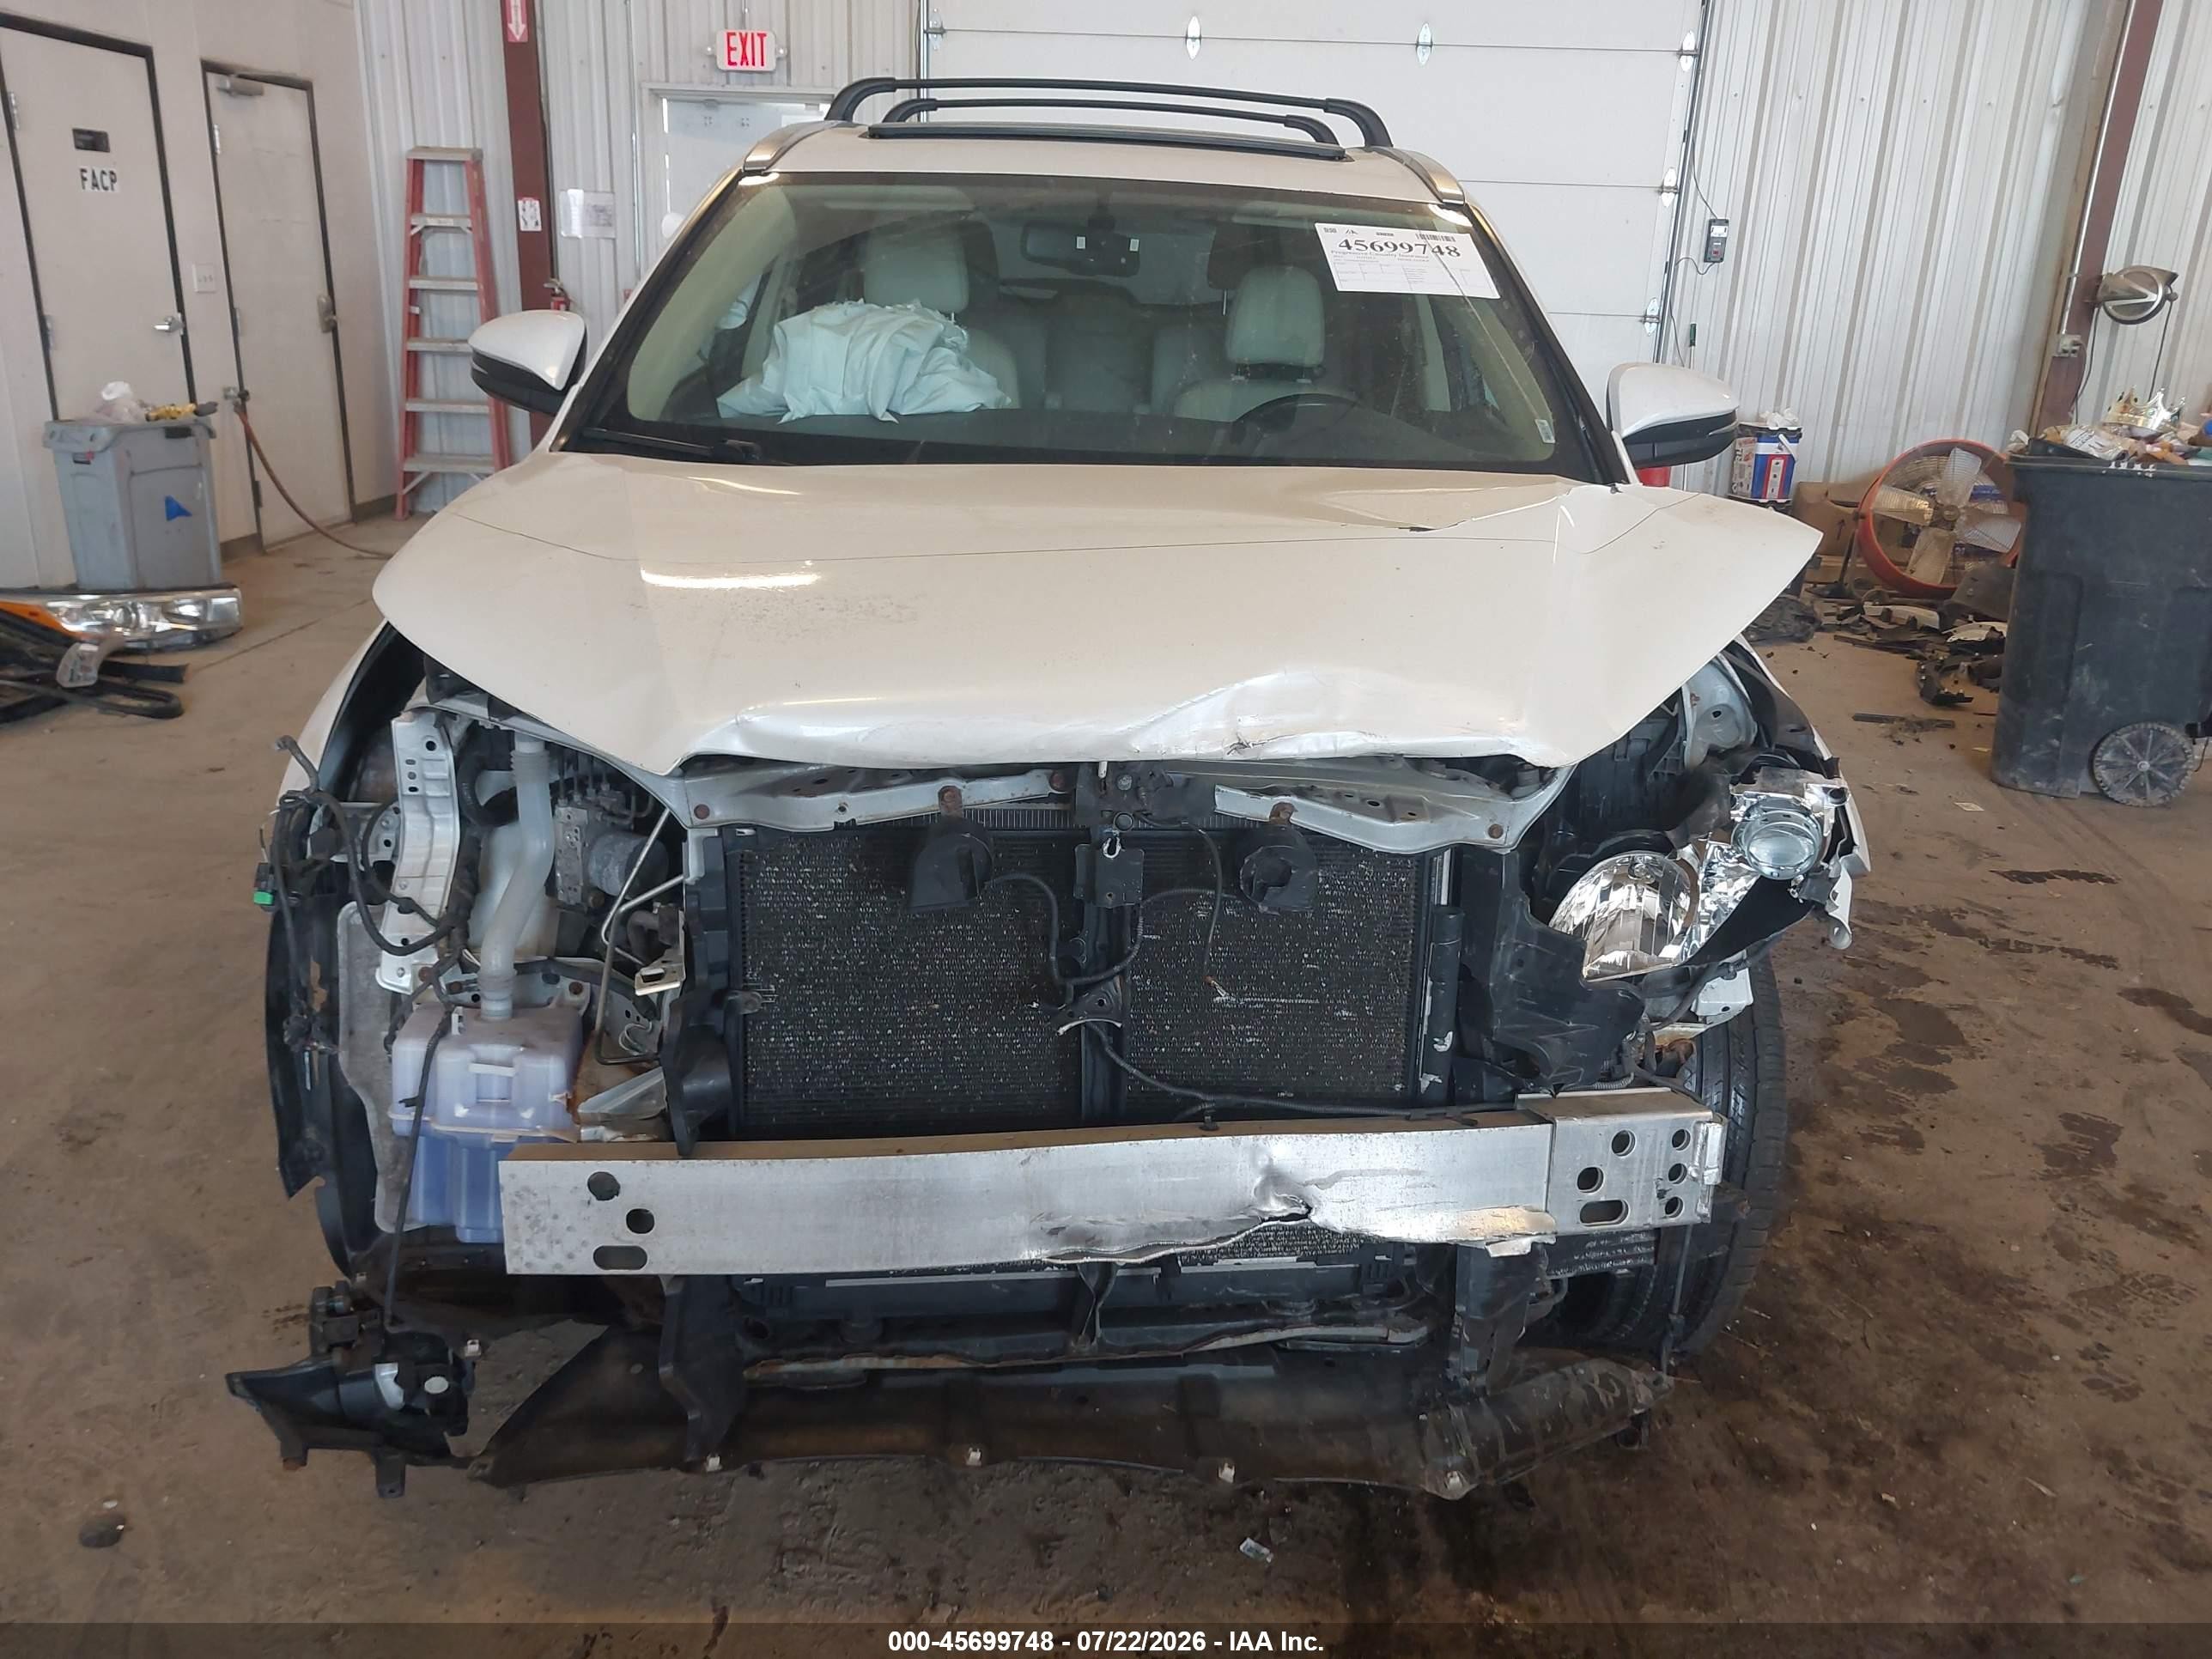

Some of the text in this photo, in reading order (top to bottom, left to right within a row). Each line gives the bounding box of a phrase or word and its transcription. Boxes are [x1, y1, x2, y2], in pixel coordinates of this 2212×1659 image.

[726, 32, 767, 67] EXIT
[80, 167, 118, 191] FACP
[1339, 239, 1462, 258] 45699748
